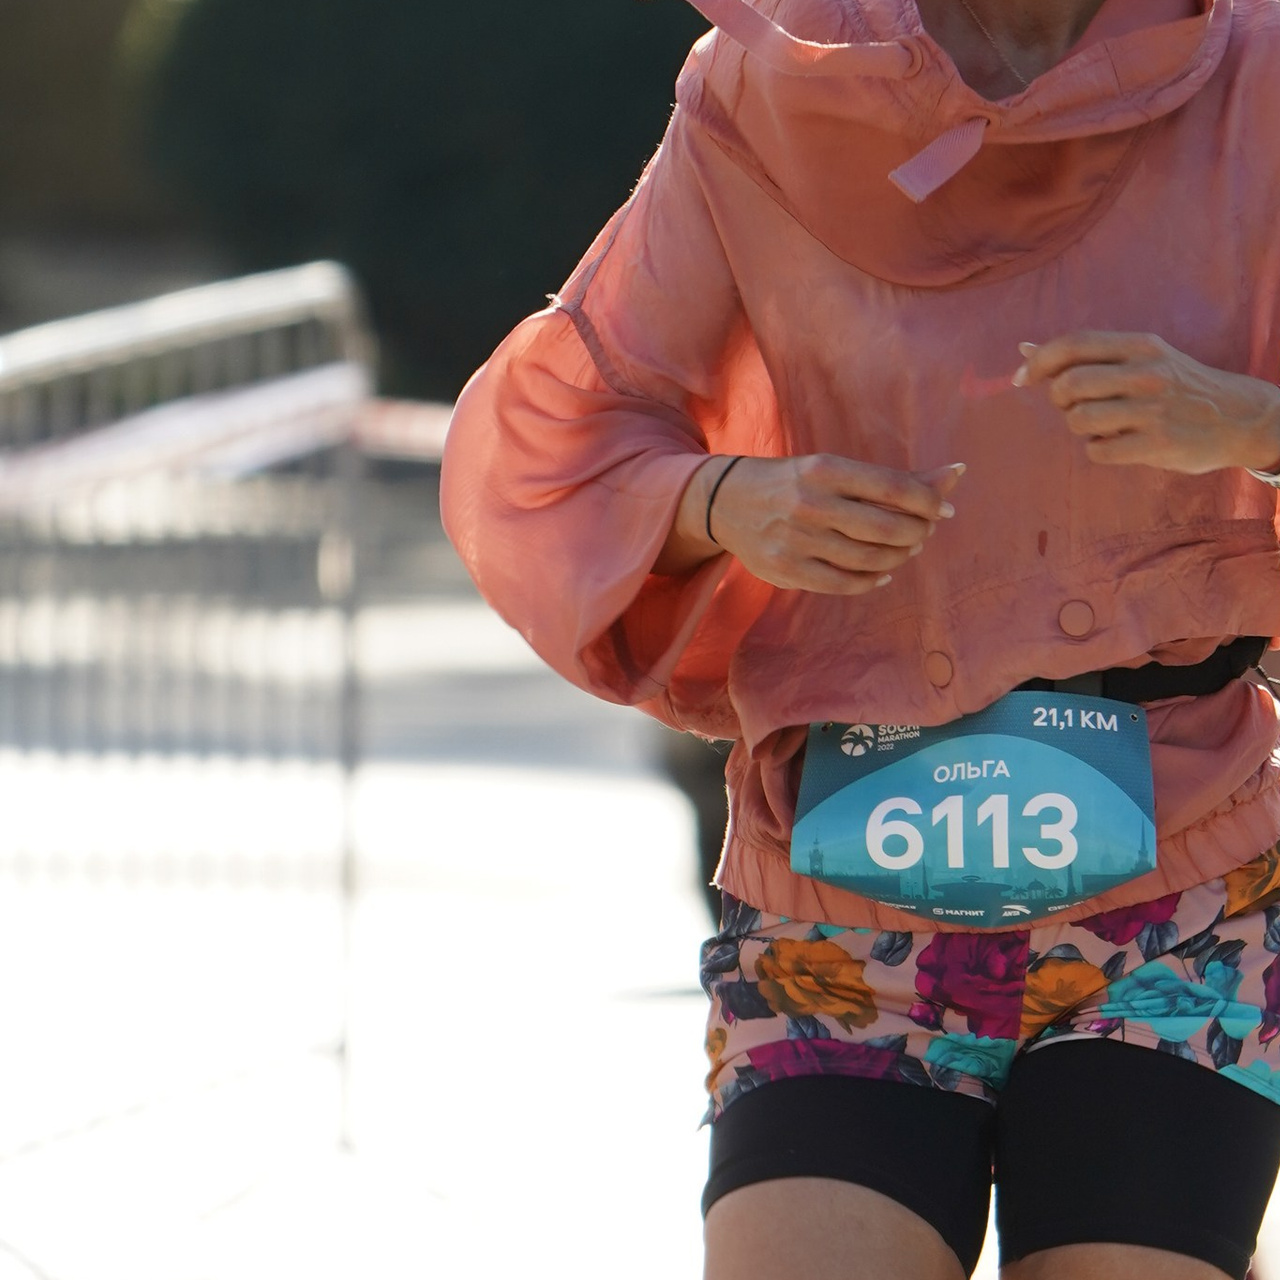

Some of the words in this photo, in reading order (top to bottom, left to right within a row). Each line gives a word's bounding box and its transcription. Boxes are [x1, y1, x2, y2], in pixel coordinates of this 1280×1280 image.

[1033, 707, 1073, 730] 21,1
[877, 730, 920, 744] MARATHON
[877, 743, 894, 752] 2022
[933, 760, 1011, 783] ОЛЬГА
[865, 792, 1079, 871] 6113
[945, 909, 985, 917] МАГНИТ
